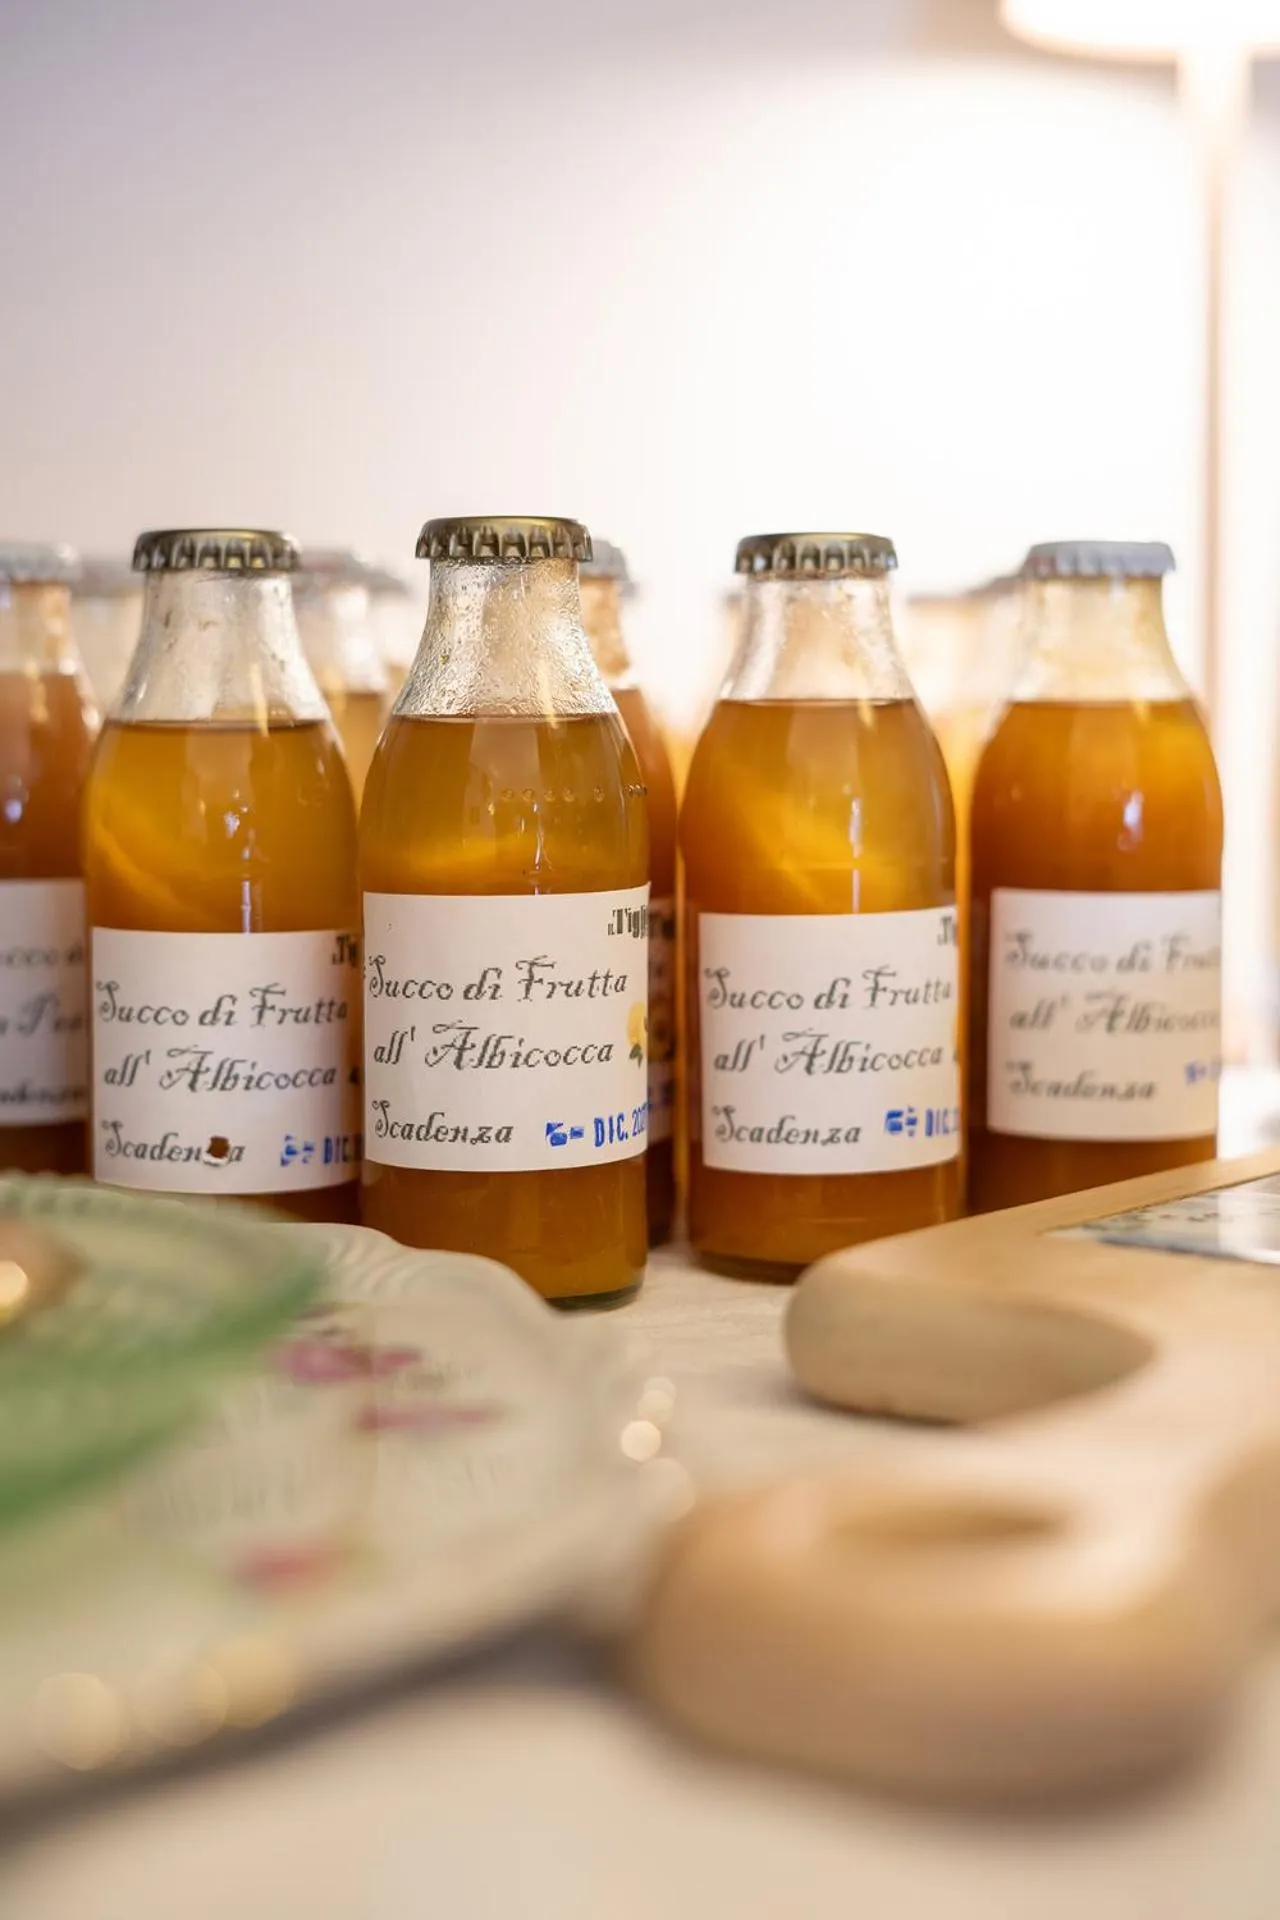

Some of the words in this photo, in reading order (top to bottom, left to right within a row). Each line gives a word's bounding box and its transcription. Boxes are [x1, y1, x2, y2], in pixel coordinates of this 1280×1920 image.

[1005, 929, 1109, 972] Succo
[1116, 939, 1153, 972] di
[368, 955, 454, 1000] Succo
[463, 967, 503, 1001] di
[515, 955, 628, 1002] Frutta
[704, 967, 804, 1010] Succo
[814, 977, 851, 1010] di
[861, 965, 952, 1008] Frutta
[96, 980, 190, 1026] Succo
[198, 994, 239, 1027] di
[249, 983, 348, 1028] Frutta
[103, 1049, 152, 1088] all'
[159, 1044, 337, 1093] Albicocca
[373, 1026, 416, 1065] all'
[424, 1020, 614, 1071] Albicocca
[713, 1034, 766, 1073] all'
[774, 1028, 943, 1076] Albicocca
[101, 1120, 246, 1168] Scadena
[371, 1100, 514, 1145] Scadenza
[711, 1105, 862, 1147] Scadenza
